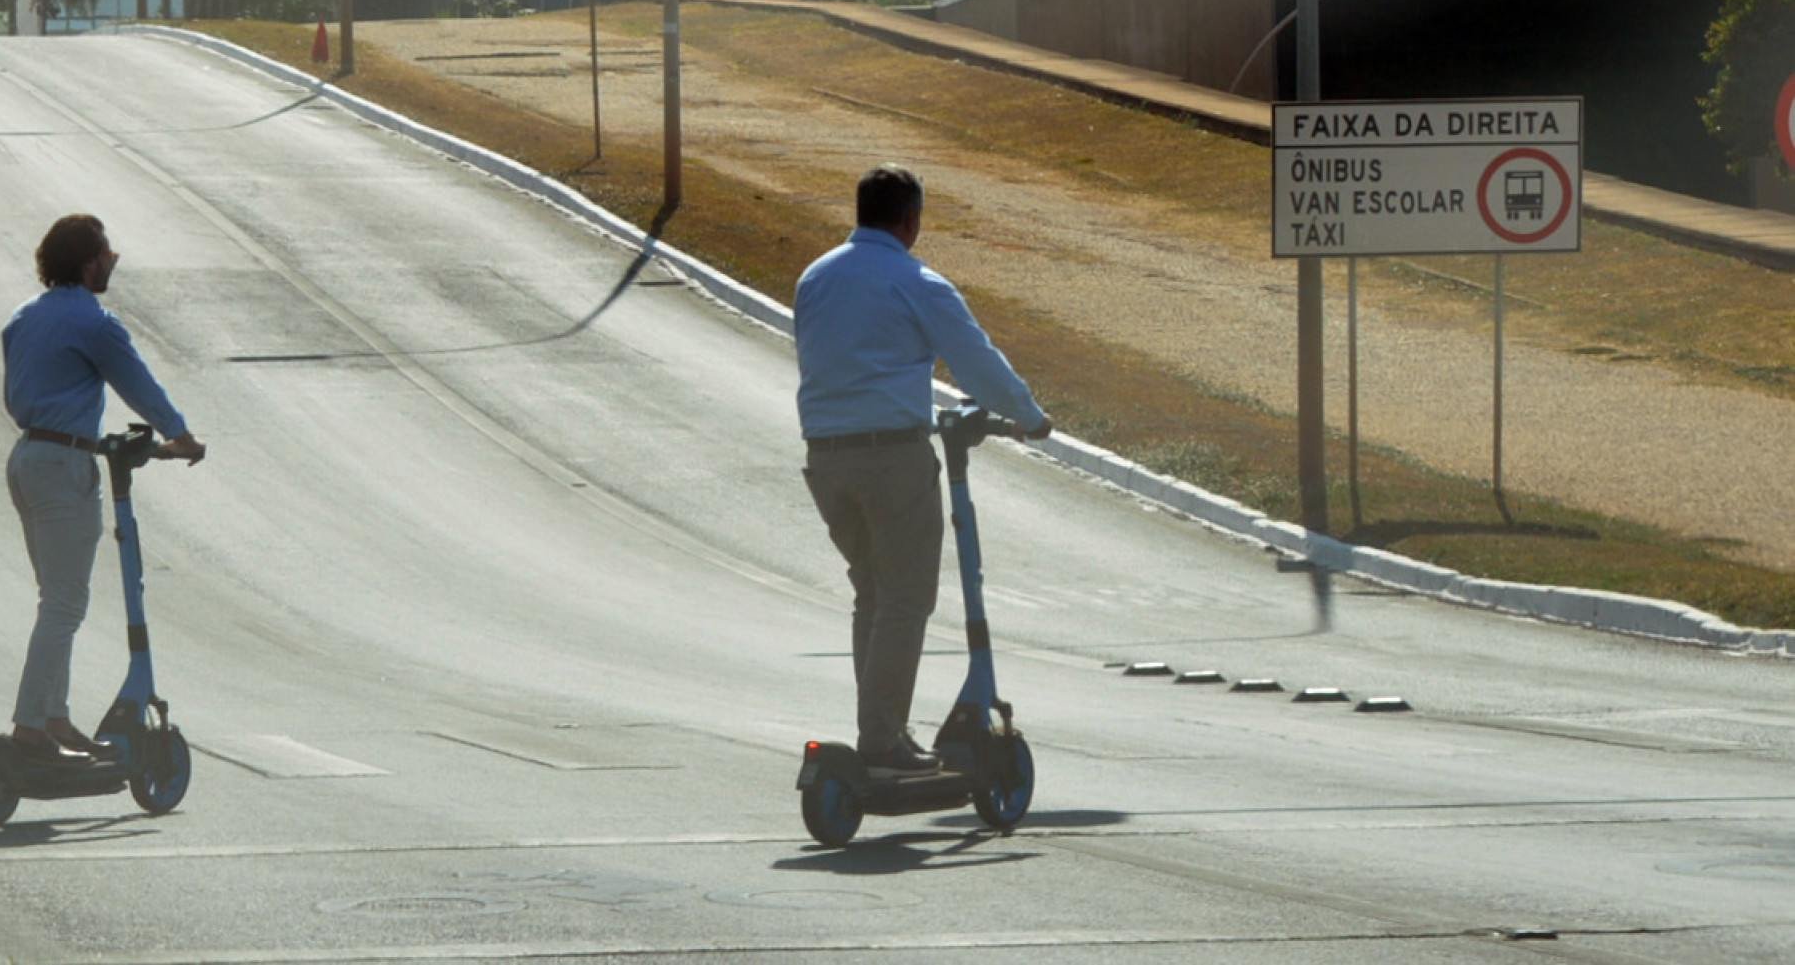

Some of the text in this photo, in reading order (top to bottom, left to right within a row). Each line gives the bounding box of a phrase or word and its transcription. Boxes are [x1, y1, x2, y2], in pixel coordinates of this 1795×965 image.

[1293, 111, 1559, 137] FAIXA DA DIREITA
[1291, 151, 1382, 182] ÔNIBUS
[1290, 190, 1464, 214] VAN ESCOLAR
[1291, 217, 1345, 247] TÁXI
